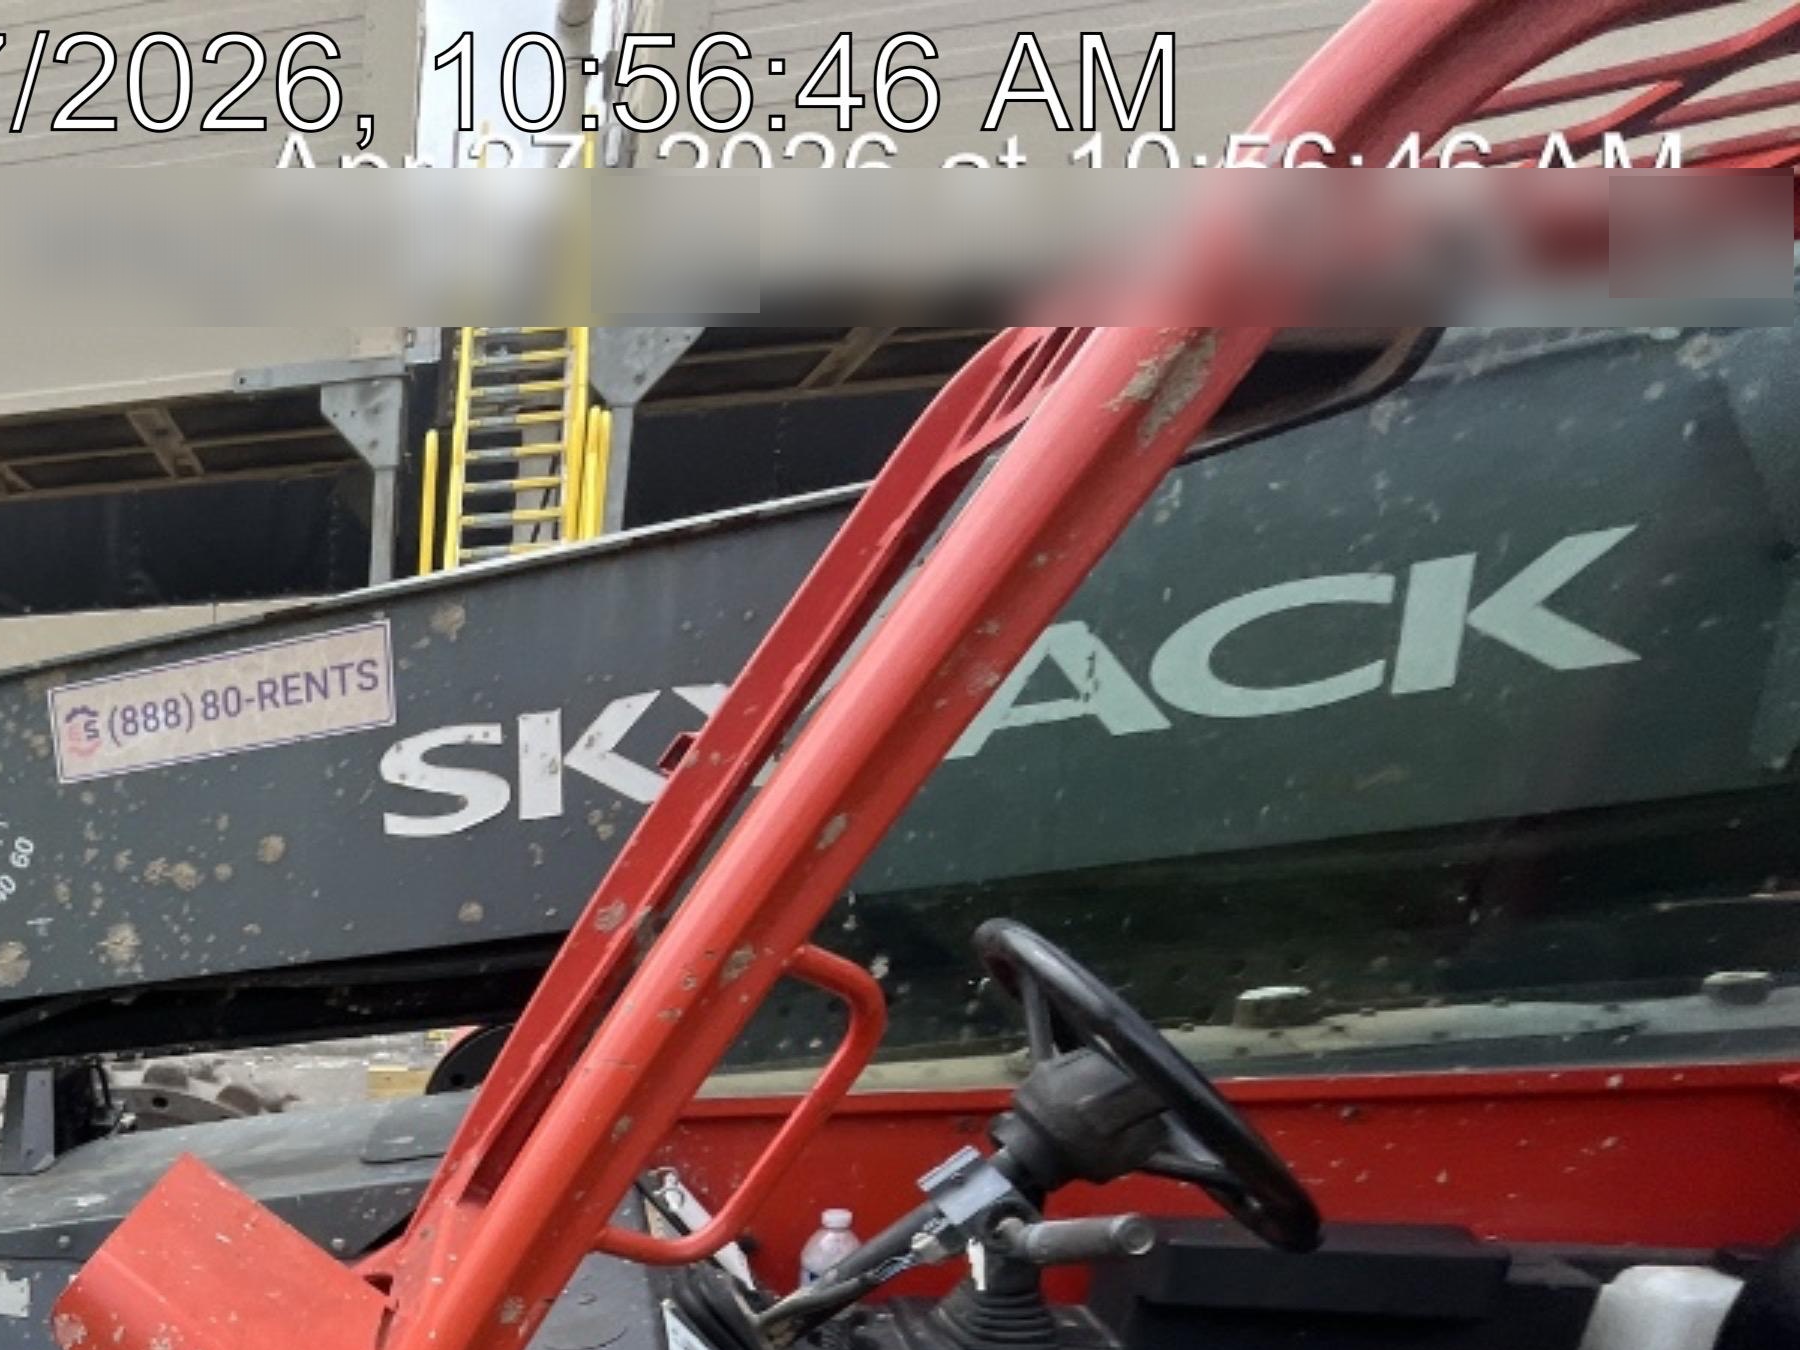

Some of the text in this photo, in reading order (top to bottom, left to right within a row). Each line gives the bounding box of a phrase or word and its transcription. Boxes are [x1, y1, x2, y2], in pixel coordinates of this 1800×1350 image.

[107, 659, 380, 747] (888) 80-RENTS
[380, 523, 1642, 838] SKACK
[8, 836, 35, 869] 60
